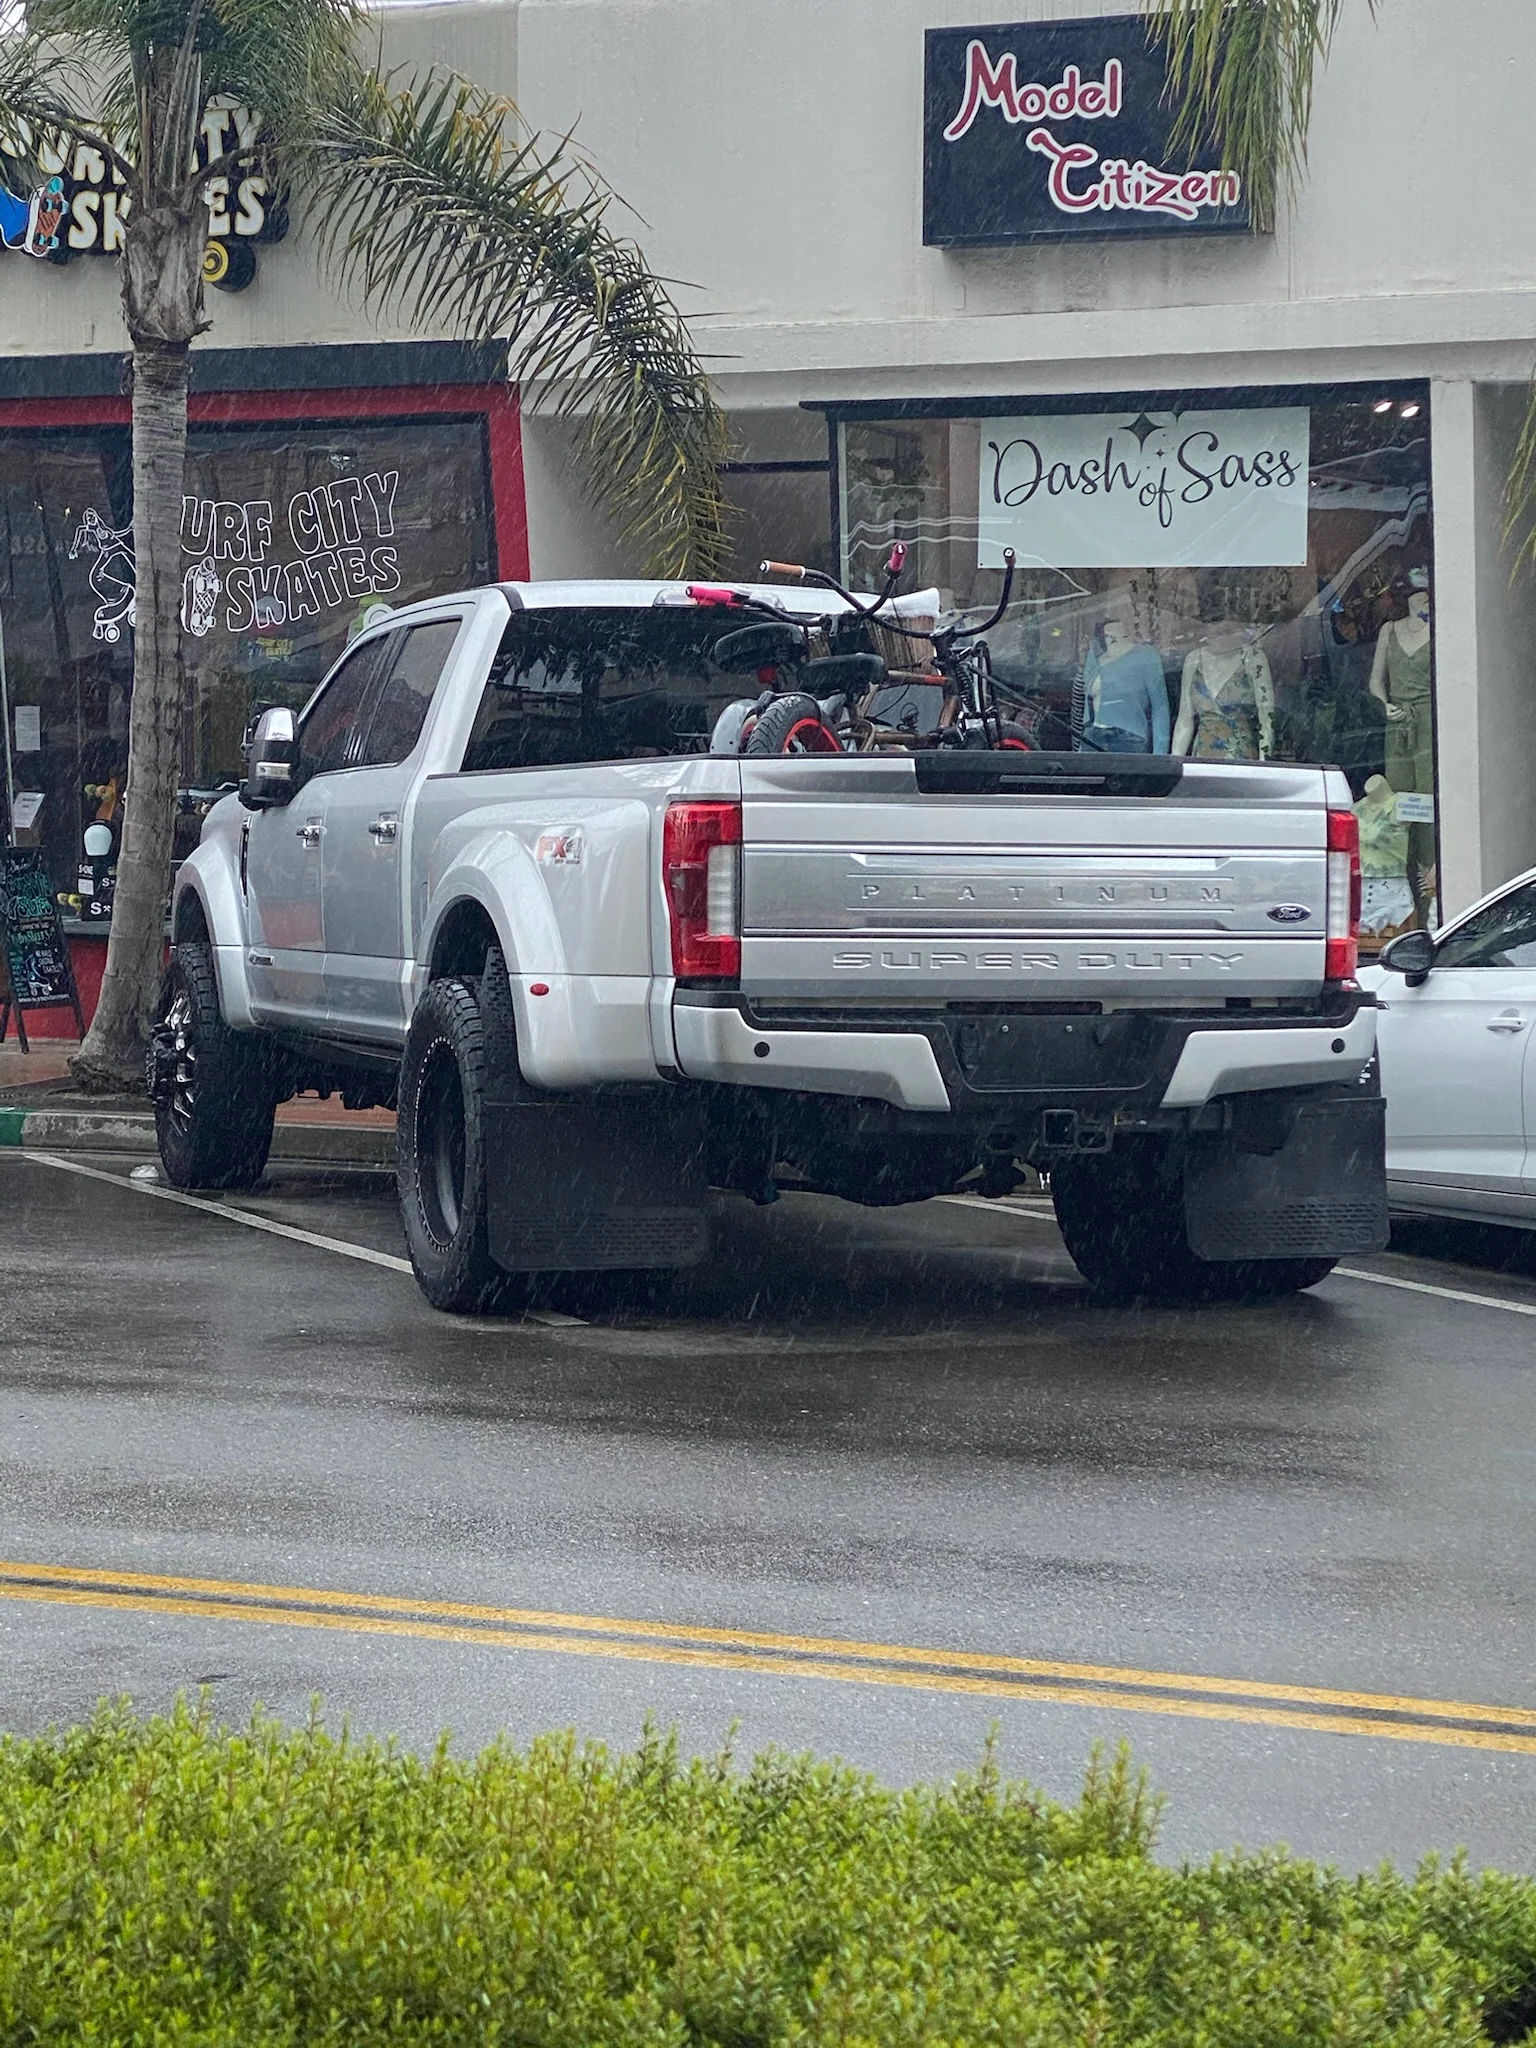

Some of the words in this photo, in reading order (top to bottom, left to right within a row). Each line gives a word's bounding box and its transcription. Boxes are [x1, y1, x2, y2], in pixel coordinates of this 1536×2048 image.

[943, 39, 1122, 141] Model
[68, 176, 268, 251] SKES
[1026, 127, 1241, 220] Citizen
[180, 495, 273, 562] URF
[288, 471, 399, 554] CITY
[988, 438, 1141, 507] Dash
[1139, 466, 1175, 528] of
[1177, 431, 1302, 503] Sass
[225, 546, 401, 632] SKATES
[536, 836, 582, 861] FX4
[861, 884, 1222, 902] PLATINUM
[832, 951, 1060, 971] SUPER
[1078, 951, 1244, 971] DUTY
